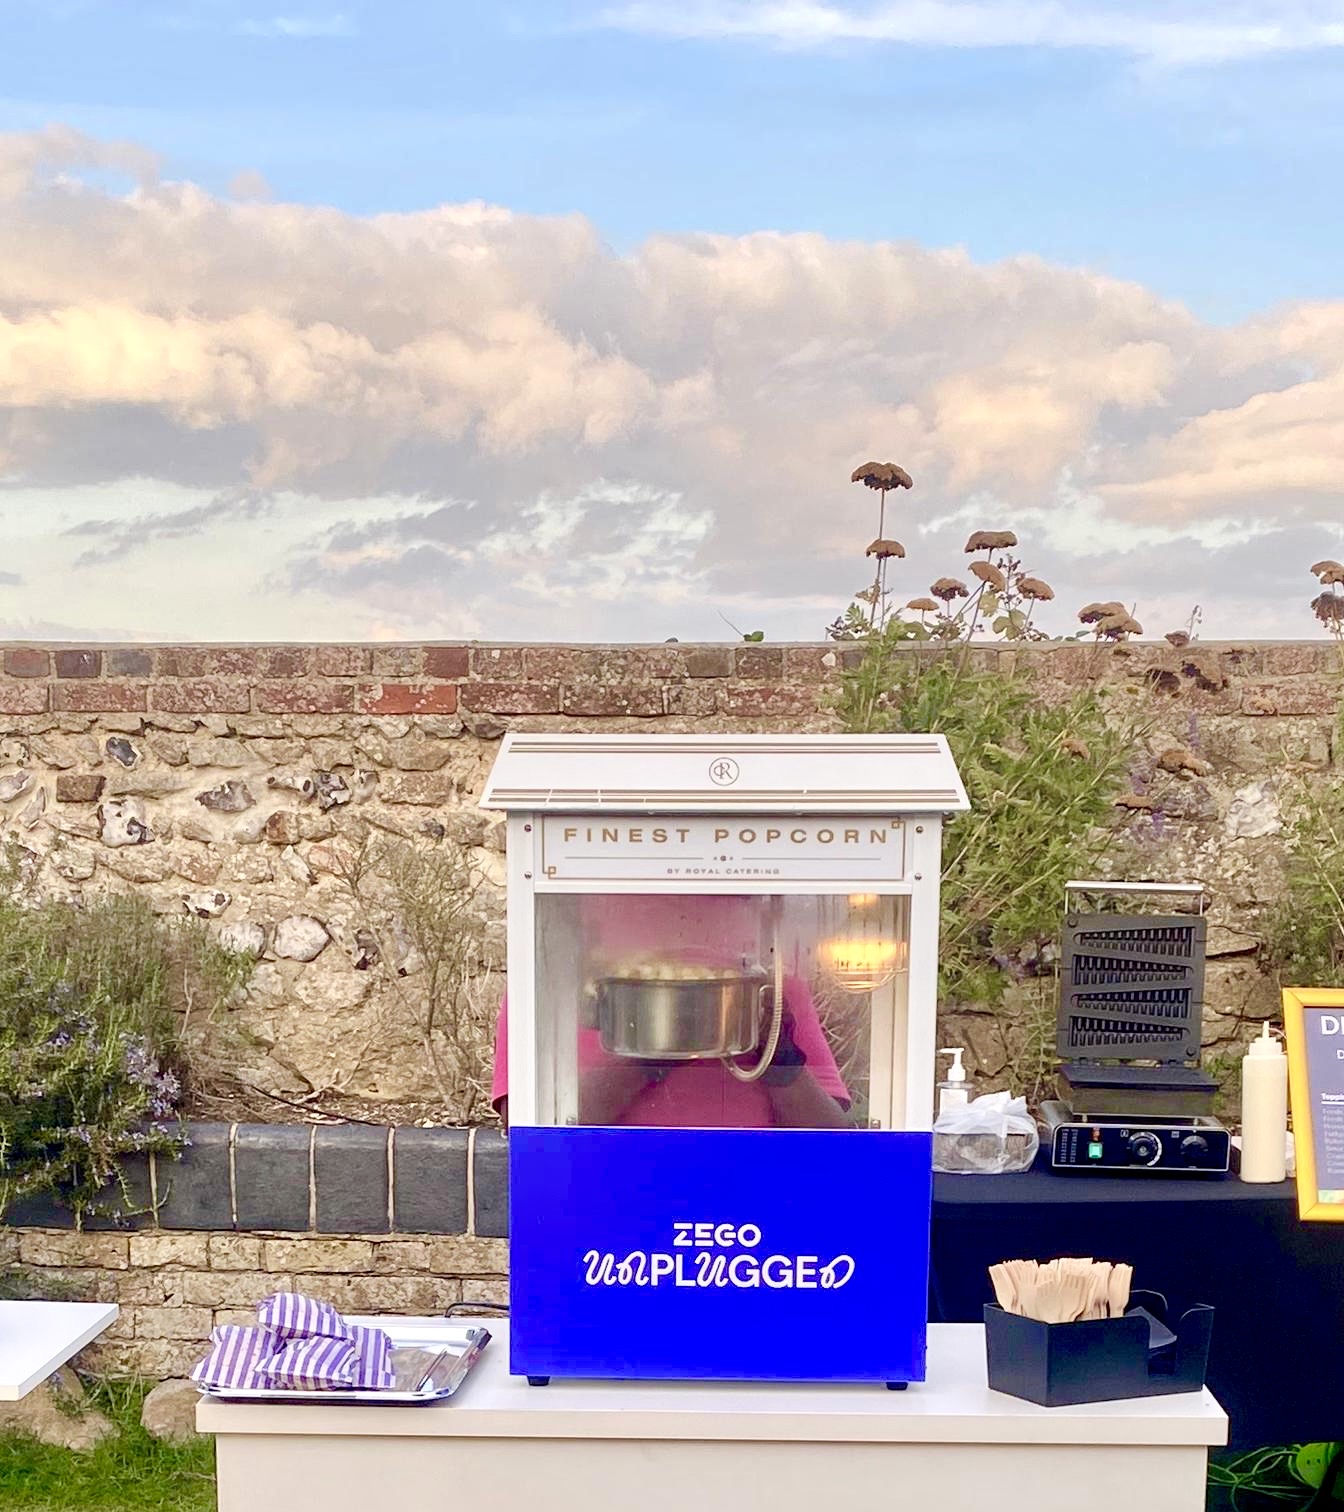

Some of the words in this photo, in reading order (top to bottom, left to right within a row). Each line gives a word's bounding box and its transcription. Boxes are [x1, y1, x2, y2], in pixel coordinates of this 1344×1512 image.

[563, 827, 691, 843] FINEST
[713, 828, 888, 844] POPCORN
[666, 867, 680, 875] BY
[725, 868, 781, 876] CATERING
[672, 1222, 763, 1248] ZEGO
[582, 1249, 856, 1290] UNPLUGGED
